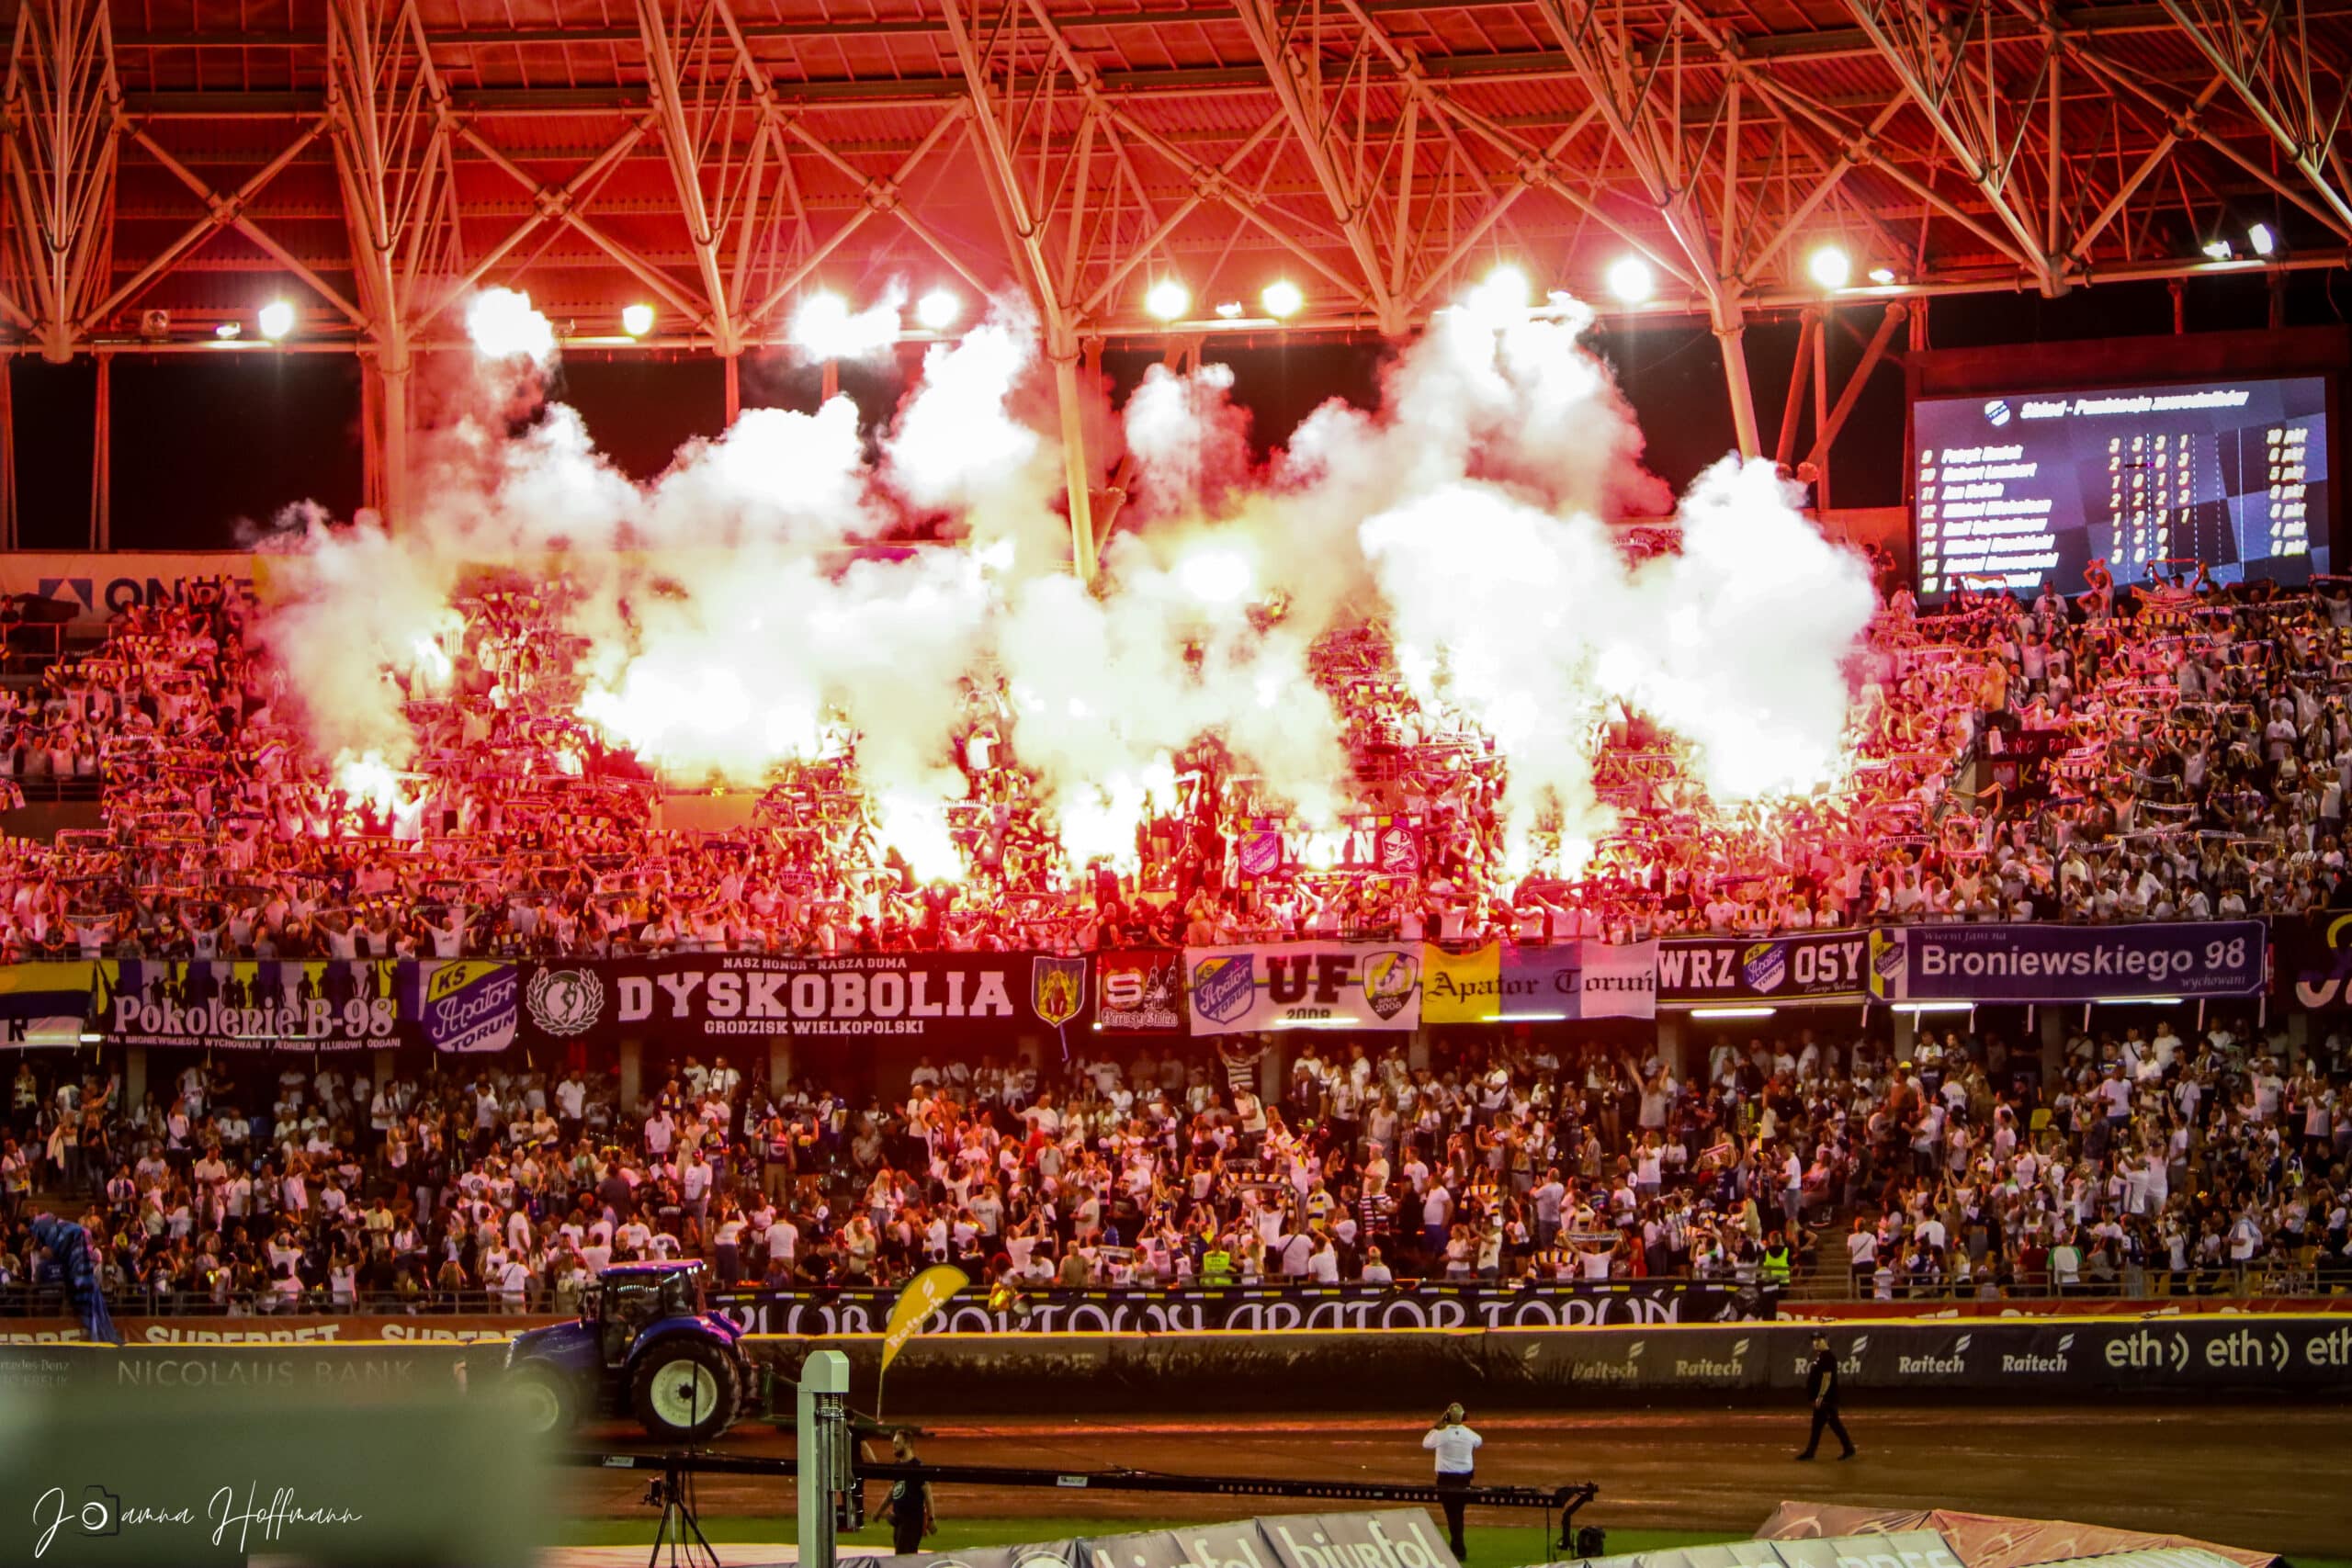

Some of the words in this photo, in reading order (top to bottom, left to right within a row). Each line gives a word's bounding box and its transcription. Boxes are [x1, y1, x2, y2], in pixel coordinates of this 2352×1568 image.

[2109, 437, 2120, 453] 3
[2132, 436, 2143, 452] 3
[2154, 434, 2166, 451] 3
[2179, 434, 2188, 449] 1
[2109, 456, 2120, 471] 2
[2177, 452, 2189, 468] 3
[2111, 475, 2120, 489] 1
[2157, 472, 2166, 486] 1
[2178, 470, 2189, 486] 3
[2109, 493, 2121, 508] 2
[2132, 491, 2144, 506] 2
[2155, 491, 2167, 505] 2
[2178, 489, 2190, 504] 3
[2112, 512, 2121, 527] 1
[2155, 509, 2167, 525] 3
[2181, 508, 2189, 523] 1
[2113, 530, 2122, 546] 1
[1281, 829, 1376, 864] MYN
[723, 957, 760, 970] NASZ
[762, 958, 808, 971] HONOR
[817, 957, 863, 970] NASZA
[866, 956, 907, 970] DUMA
[1794, 941, 1864, 984] OSY
[1922, 944, 2194, 982] Broniewskiego
[2204, 937, 2245, 970] 98
[437, 964, 467, 993] KS
[1266, 953, 1357, 1005] UF
[1424, 971, 1540, 1004] Apator
[1554, 968, 1655, 994] Toruń
[2180, 974, 2245, 990] wychowani
[432, 971, 518, 1040] Apator
[617, 971, 1013, 1022] DYSKOBOLIA
[113, 994, 297, 1038] Pokolenie
[305, 997, 395, 1039] B-98
[704, 1019, 788, 1035] GRODZISK
[792, 1020, 925, 1035] WIELKOPOLSKI
[2105, 1329, 2164, 1368] eth
[2205, 1328, 2264, 1367] eth
[117, 1359, 294, 1387] NICOLAUS
[315, 1359, 414, 1384] BANK
[1675, 1359, 1743, 1377] Raitech
[1898, 1354, 1965, 1374] Raitech
[2002, 1353, 2068, 1372] Raitech
